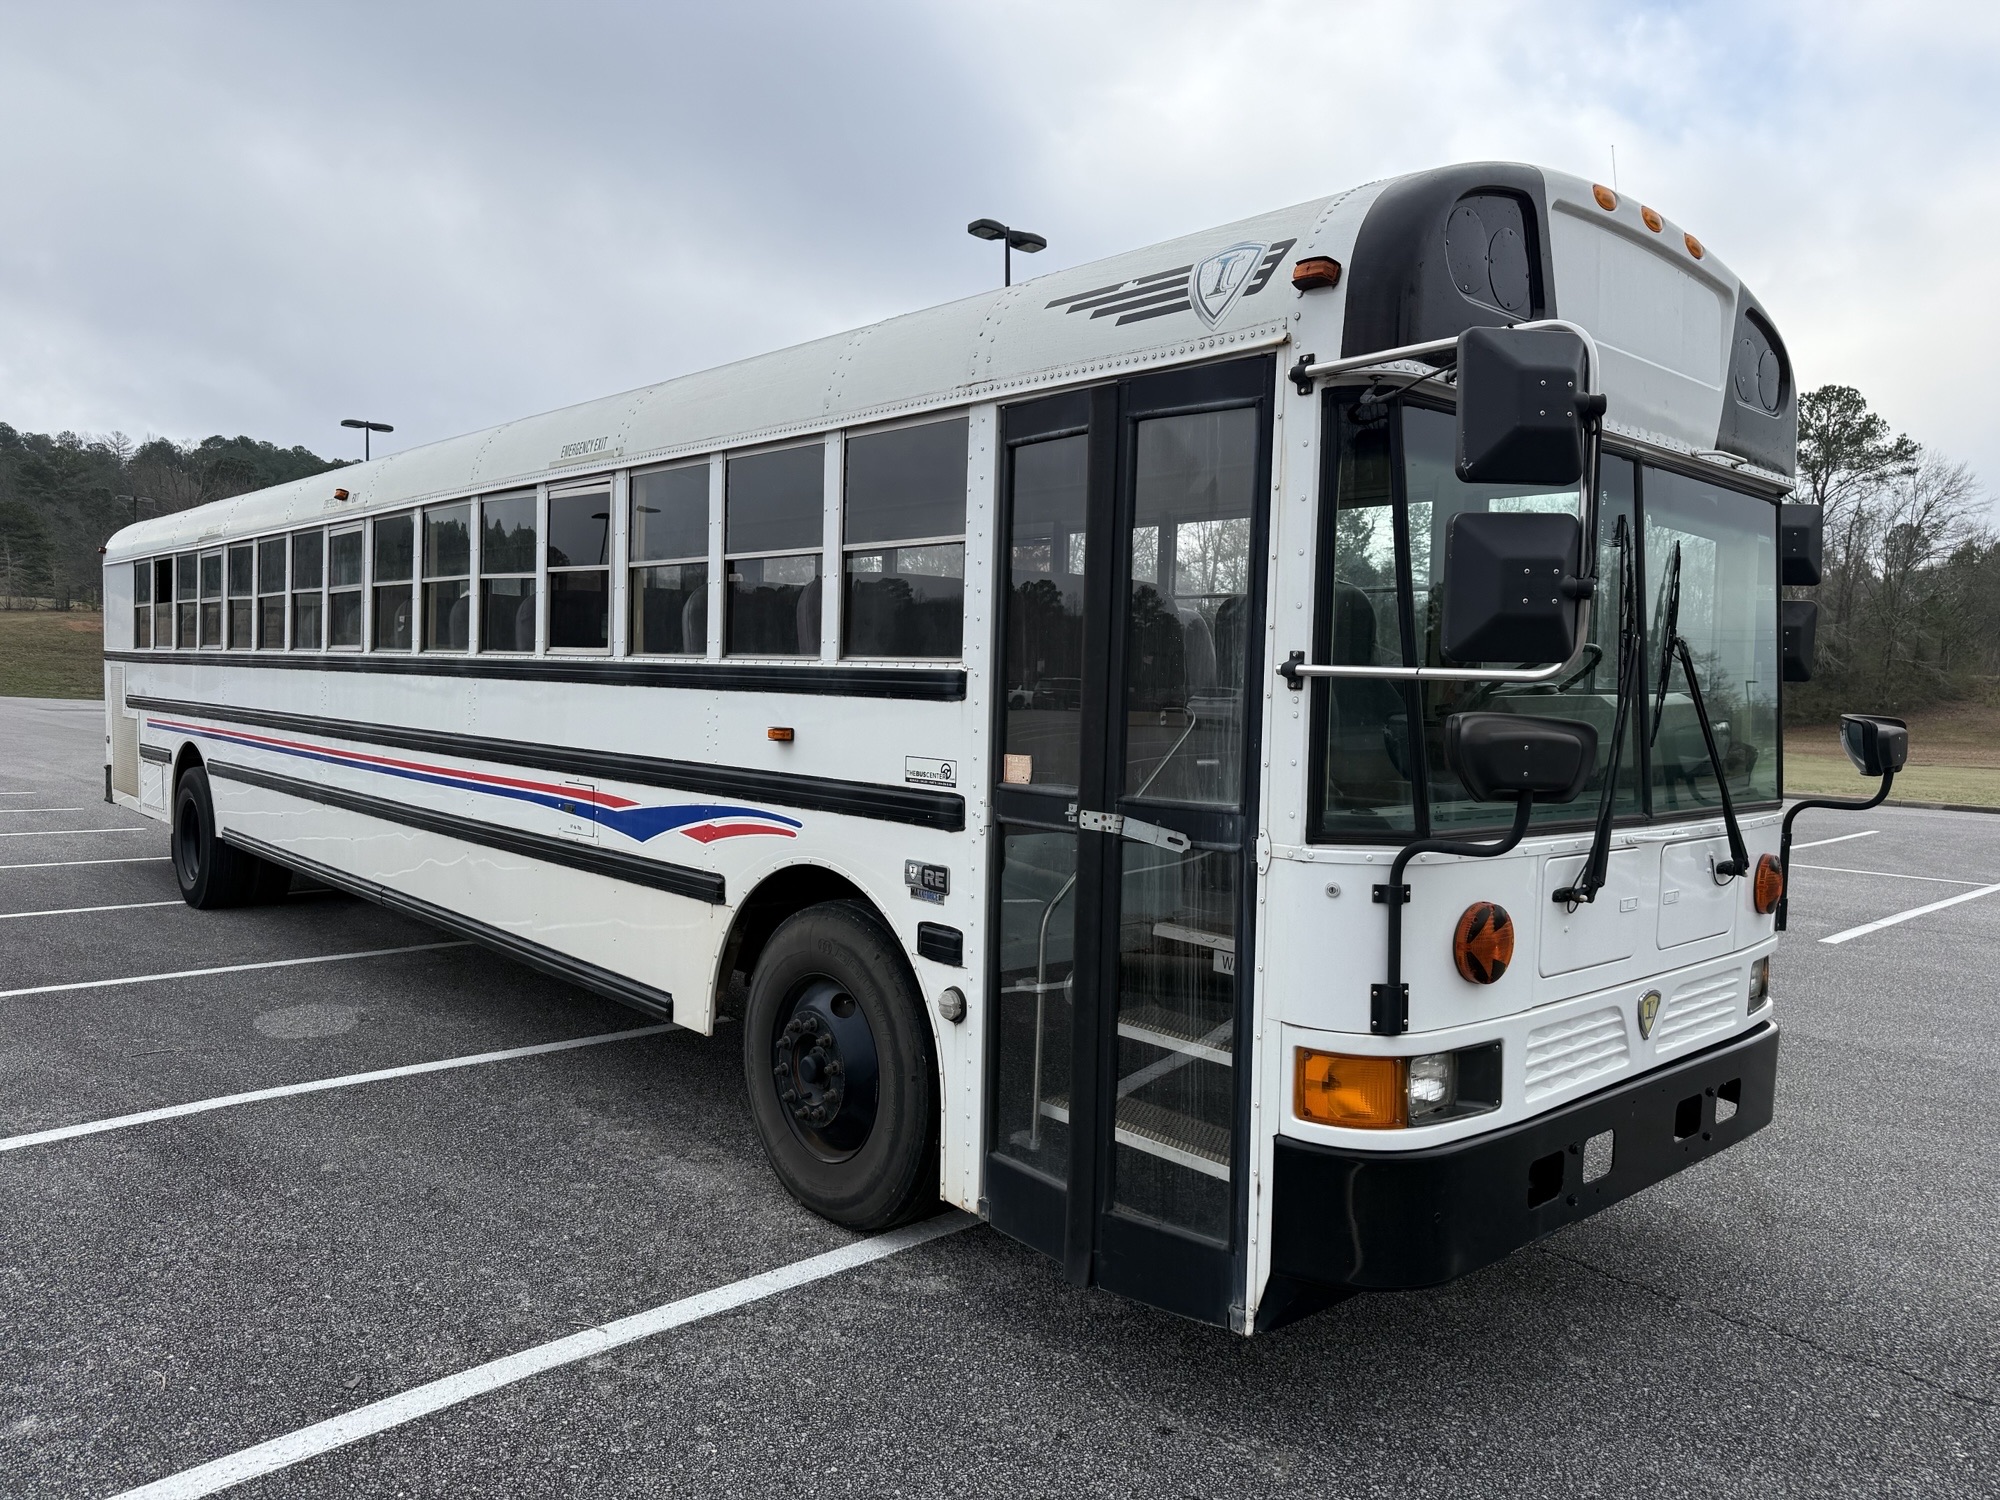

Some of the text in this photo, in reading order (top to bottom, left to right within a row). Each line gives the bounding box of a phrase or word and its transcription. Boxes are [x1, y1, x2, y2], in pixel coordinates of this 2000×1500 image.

[560, 436, 608, 459] EMERGENCY EXIT
[924, 869, 945, 888] RE
[1221, 955, 1235, 971] W
